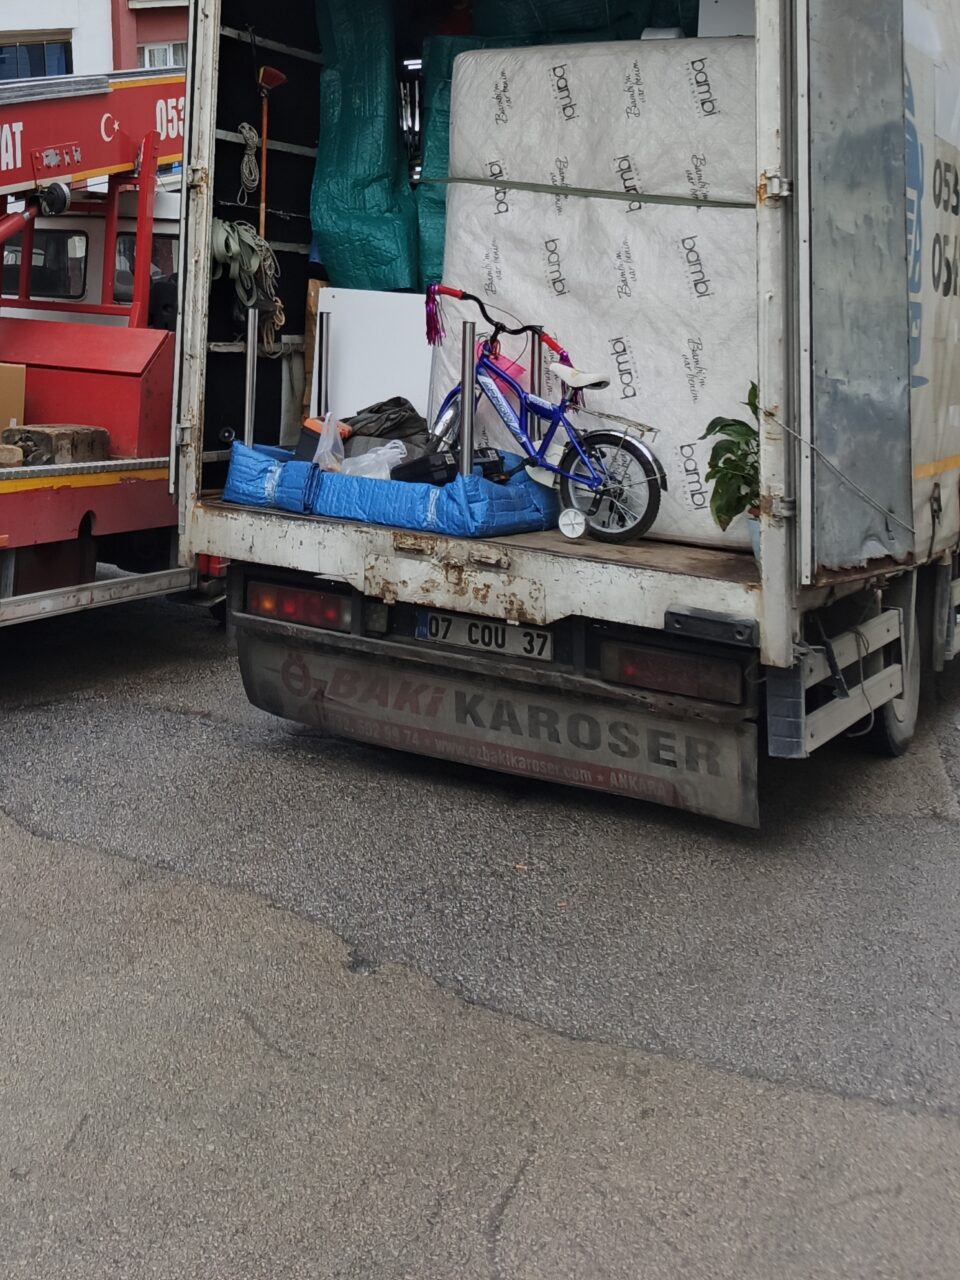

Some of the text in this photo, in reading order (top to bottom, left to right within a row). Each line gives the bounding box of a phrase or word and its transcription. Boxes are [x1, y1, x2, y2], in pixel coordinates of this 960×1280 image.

[552, 63, 580, 121] bambi
[691, 57, 721, 117] bambi
[545, 238, 569, 297] bambi
[681, 235, 715, 298] bambi
[608, 336, 637, 400] bambi
[680, 442, 709, 511] bambi
[428, 615, 453, 640] 07
[468, 622, 507, 649] COU
[522, 631, 549, 657] 37
[453, 689, 723, 777] KAROSER
